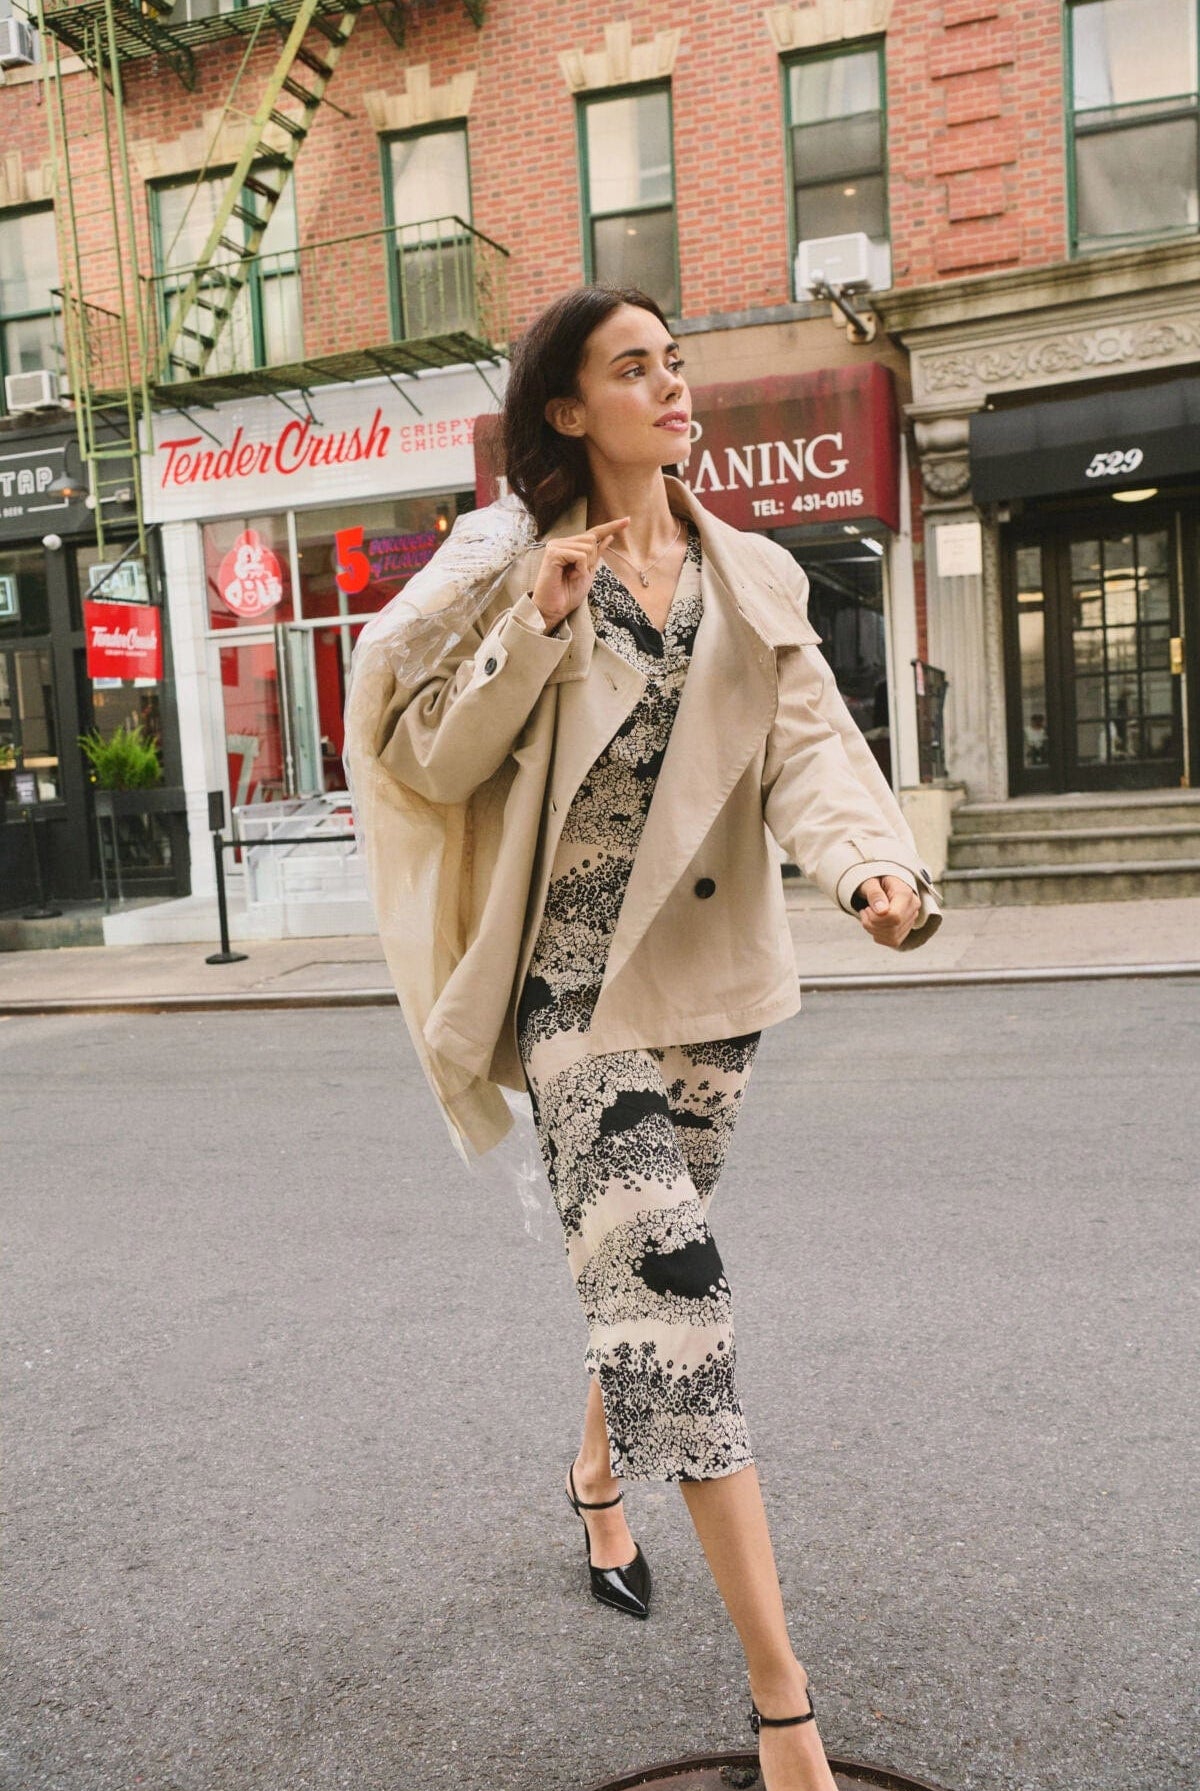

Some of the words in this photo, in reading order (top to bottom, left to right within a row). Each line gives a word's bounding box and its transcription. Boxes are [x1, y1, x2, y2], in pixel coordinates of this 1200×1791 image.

[400, 418, 477, 438] CRISPY
[159, 407, 391, 488] TenderCrush
[1085, 448, 1144, 478] 529
[0, 466, 53, 497] TAP
[752, 500, 784, 517] TEL:
[791, 488, 863, 512] 431-0115
[335, 525, 370, 594] 5
